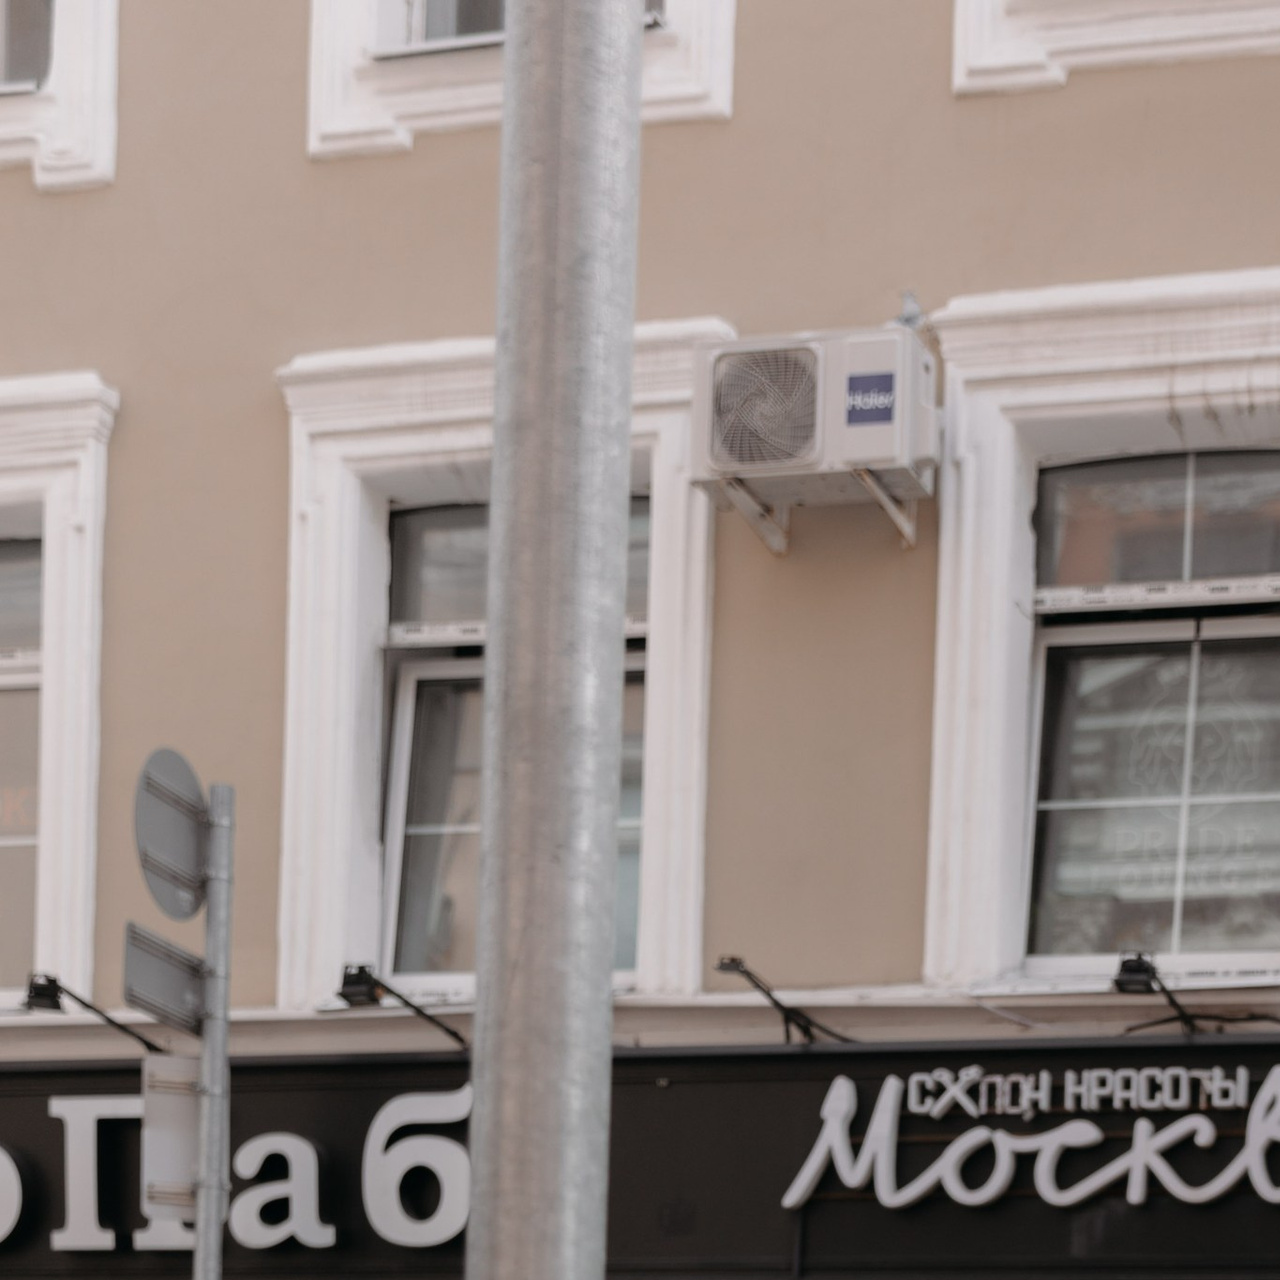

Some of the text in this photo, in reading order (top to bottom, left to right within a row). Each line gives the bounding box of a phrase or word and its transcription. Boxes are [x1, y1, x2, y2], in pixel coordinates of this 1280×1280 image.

[846, 388, 894, 410] Haier
[1113, 824, 1260, 863] PRDE
[0, 1082, 472, 1250] Паб
